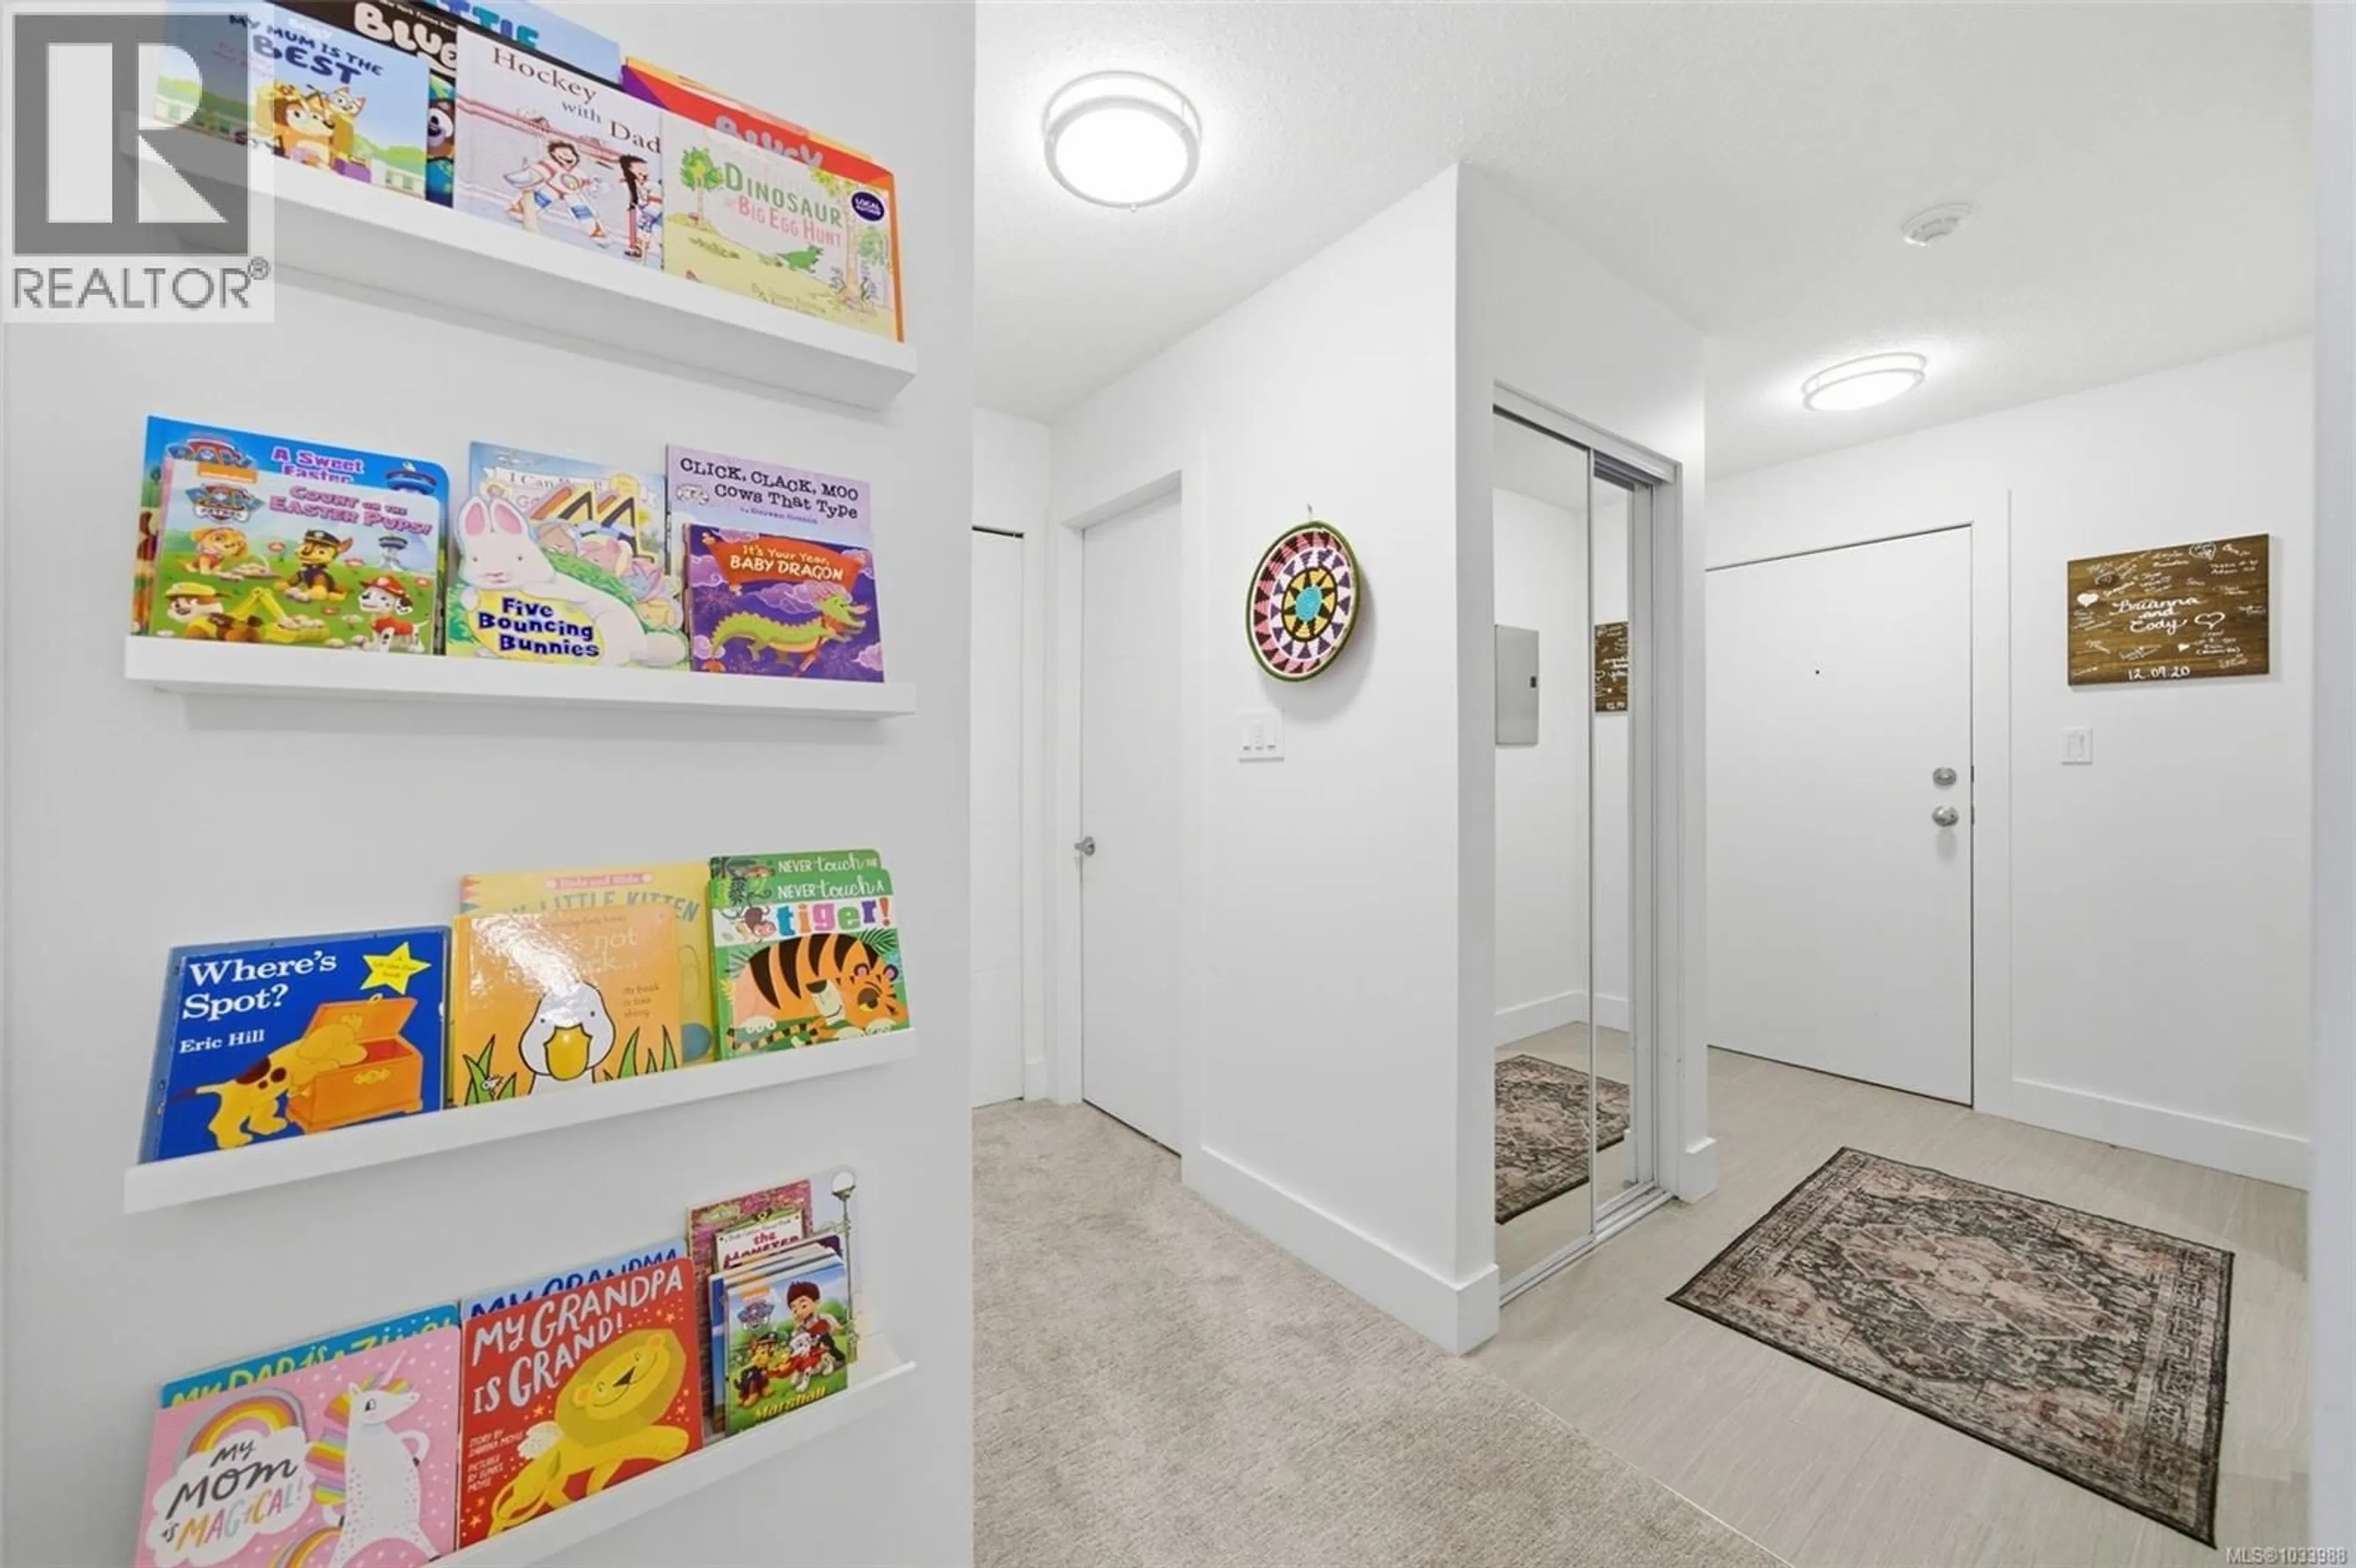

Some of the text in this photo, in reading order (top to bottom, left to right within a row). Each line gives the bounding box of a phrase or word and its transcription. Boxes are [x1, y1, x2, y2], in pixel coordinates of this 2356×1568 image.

[229, 15, 260, 29] MY
[267, 26, 315, 48] MUM
[320, 43, 341, 58] IS
[345, 52, 384, 77] THE
[252, 34, 362, 84] BEST
[493, 47, 597, 104] Hockey
[561, 101, 661, 153] with Dad
[724, 162, 842, 228] DINOSAUR
[738, 194, 843, 247] BIG EGG HUNT
[272, 447, 290, 461] A
[298, 450, 364, 473] Sweet
[680, 458, 859, 501] CLICK, CLACK, MOO
[269, 495, 360, 525] EASTER
[768, 491, 812, 511] That
[742, 544, 763, 557] It's
[768, 548, 796, 560] Your
[730, 555, 844, 582] BABY DRAGON
[502, 597, 553, 617] Five
[2109, 597, 2203, 615] Brianna
[2139, 607, 2179, 619] and
[479, 612, 593, 642] Bouncing
[499, 633, 599, 656] Bunnies
[778, 859, 812, 873] NEVER
[816, 851, 862, 872] touch
[778, 874, 885, 899] NEVER touch A
[776, 896, 890, 937] tiger!
[189, 950, 337, 986] Where's
[183, 983, 289, 1021] Spot?
[179, 1029, 265, 1054] Eric Hill
[753, 1231, 776, 1245] the
[472, 1314, 525, 1367] MY
[530, 1265, 683, 1348] GRANDPA
[473, 1376, 501, 1415] IS
[508, 1312, 623, 1407] GRAND!
[174, 1476, 304, 1551] MAGICAL!
